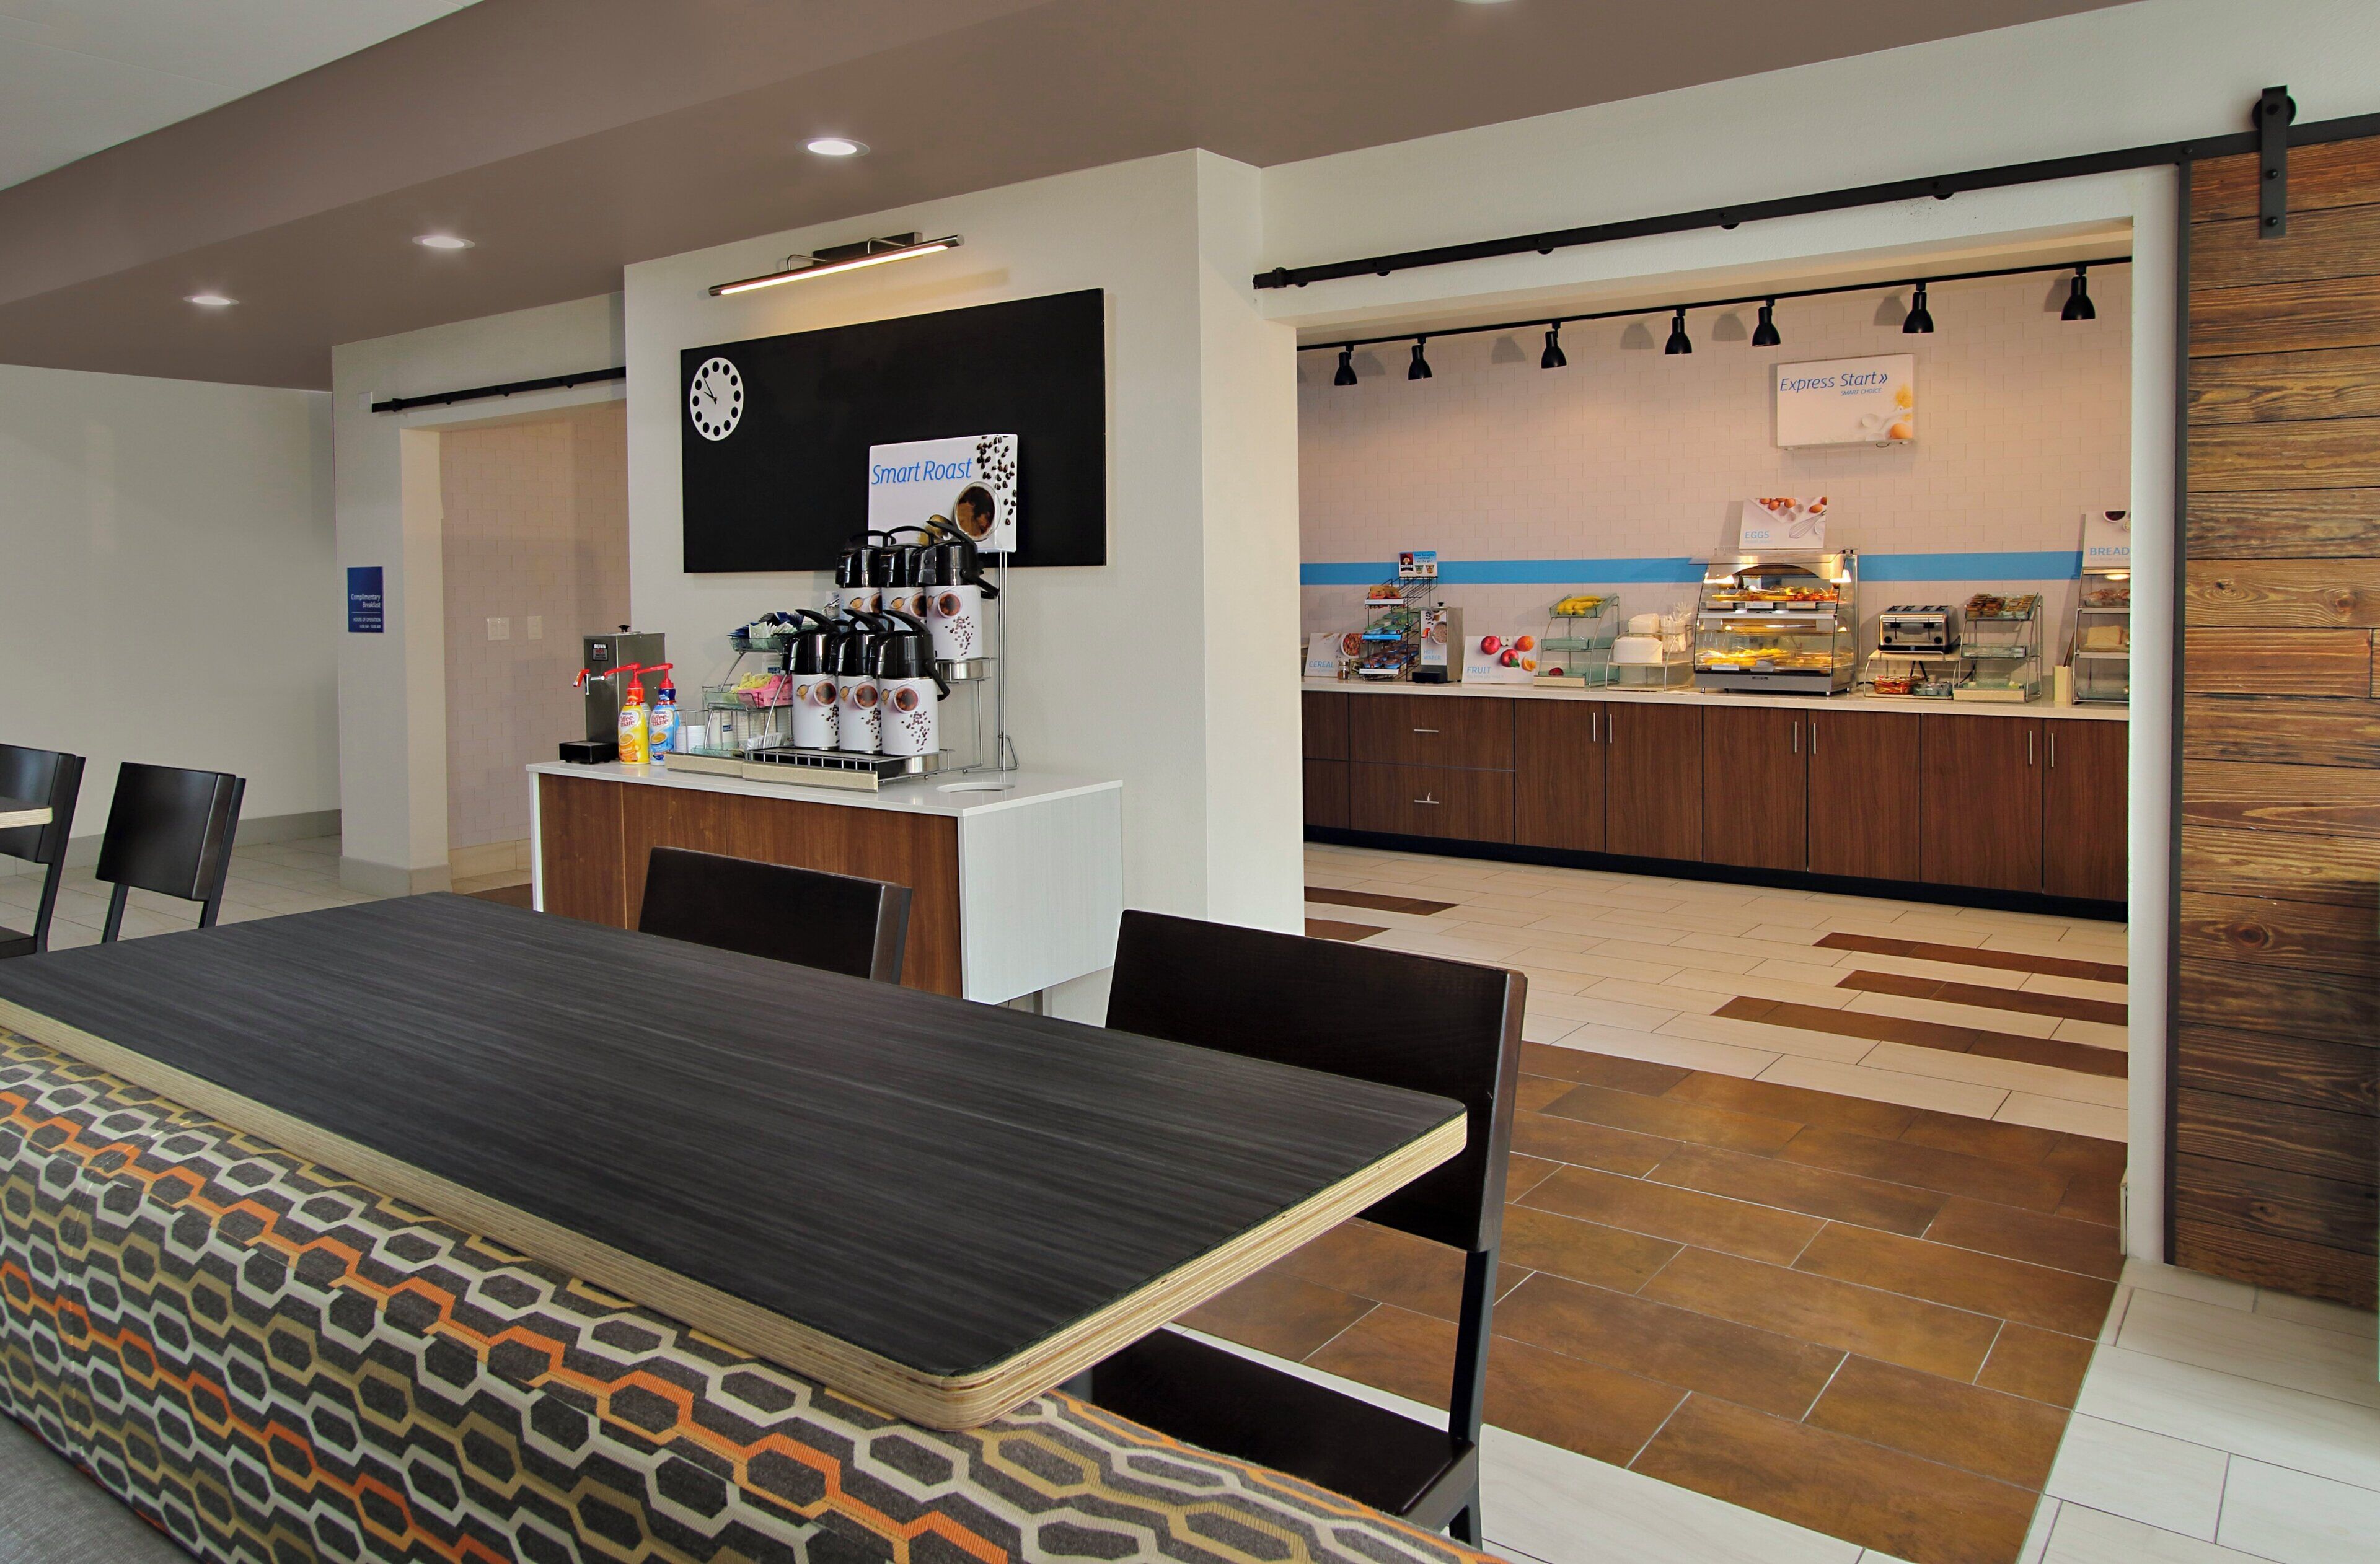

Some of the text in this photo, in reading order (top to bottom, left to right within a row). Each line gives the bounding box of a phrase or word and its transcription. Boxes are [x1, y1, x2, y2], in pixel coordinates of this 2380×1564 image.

[1780, 371, 1877, 393] Express Start
[871, 457, 972, 485] Smart Roast
[2089, 547, 2130, 555] BREAD
[1467, 666, 1492, 674] FRUIT
